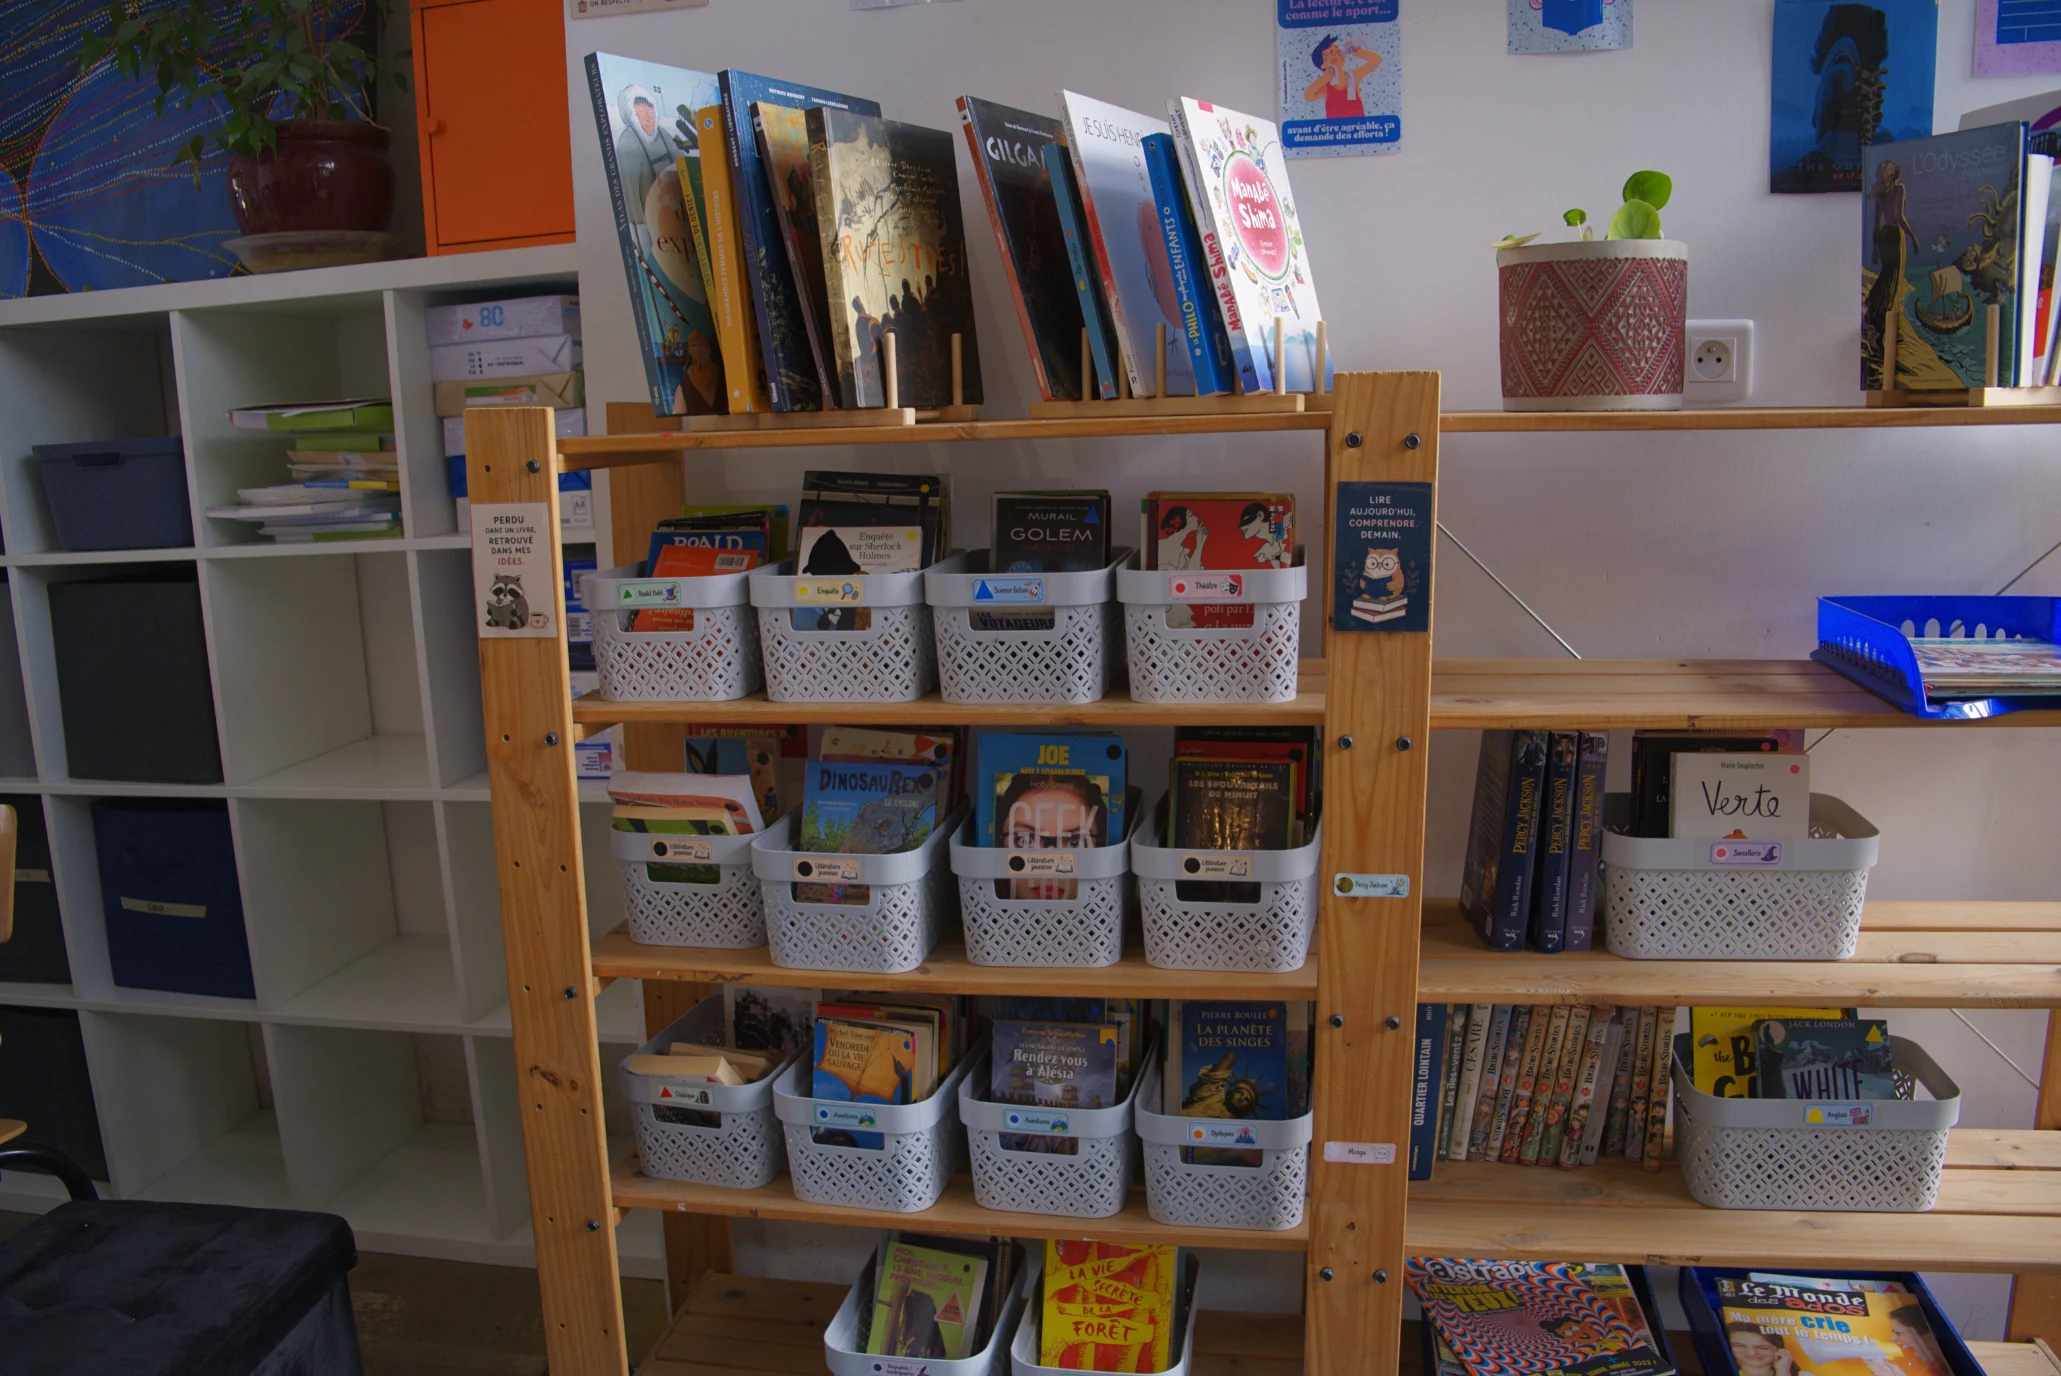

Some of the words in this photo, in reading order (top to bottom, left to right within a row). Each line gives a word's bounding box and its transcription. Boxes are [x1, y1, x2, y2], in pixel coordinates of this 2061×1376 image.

[1285, 9, 1330, 20] comme
[1332, 7, 1343, 17] le
[1287, 126, 1311, 134] avant
[1313, 124, 1340, 133] d'être
[1341, 121, 1382, 132] agréable,
[1294, 133, 1335, 142] demande
[1336, 131, 1351, 140] des
[1353, 129, 1383, 139] efforts
[1913, 142, 2005, 175] L'Odyssée
[1798, 162, 1827, 171] THE
[1238, 203, 1276, 230] Shima
[1165, 217, 1182, 269] ENFANTS
[717, 242, 727, 275] FEMMES
[1203, 232, 1227, 278] Shima
[720, 275, 732, 313] GRANDES
[1369, 495, 1392, 504] LIRE
[1027, 512, 1076, 521] MURAIL
[1349, 507, 1416, 517] AUJOURD'HUI,
[493, 516, 525, 525] PERDU
[488, 536, 534, 545] RETROUVÉ
[859, 532, 894, 542] Enquête
[1010, 528, 1093, 541] GOLEM
[1360, 530, 1402, 539] DEMAIN.
[491, 547, 513, 555] DANS
[864, 542, 902, 551] Sherlock
[498, 556, 526, 566] IDÉES.
[858, 551, 891, 560] Holmes
[817, 587, 840, 596] Enquête
[1195, 582, 1218, 590] Théâtre
[1226, 605, 1244, 615] par
[979, 617, 1055, 630] VOYAGEURS
[1037, 745, 1070, 765] JOE
[1518, 776, 1535, 821] JACKSON
[1552, 777, 1568, 821] JACKSON
[1581, 774, 1596, 818] JACKSON
[1701, 779, 1781, 818] Verte
[1513, 822, 1530, 855] PERCY
[1549, 821, 1565, 855] PERCY
[1577, 818, 1592, 852] PERCY
[1733, 849, 1762, 857] Sorcellerie
[1355, 880, 1369, 890] Percy
[1554, 875, 1565, 902] Riordan
[1511, 899, 1520, 918] Rick
[1551, 901, 1561, 918] Rick
[1578, 896, 1587, 914] Rick
[1201, 1010, 1231, 1020] PIERRE
[1234, 1011, 1268, 1020] BOULLE
[1197, 1023, 1213, 1035] LA
[1217, 1023, 1273, 1035] PLANÈTE
[1788, 1021, 1811, 1029] JACK
[1814, 1020, 1856, 1029] LONDON
[829, 1037, 869, 1053] VENDREDI
[1198, 1037, 1222, 1047] DES
[1225, 1037, 1271, 1047] SINGES
[1465, 1019, 1485, 1073] CESARE
[828, 1048, 839, 1057] OU
[841, 1051, 851, 1060] LA
[853, 1053, 865, 1062] VIE
[1420, 1037, 1432, 1081] LOINTAIN
[1713, 1050, 1734, 1063] the
[827, 1058, 863, 1072] SAUVAGE
[1025, 1062, 1033, 1076] à
[1036, 1064, 1074, 1080] Alésia
[1444, 1090, 1455, 1107] Les
[1451, 1041, 1461, 1066] vent
[1414, 1081, 1429, 1126] QUARTIER
[1827, 1111, 1848, 1121] Anglais
[1348, 1148, 1366, 1158] Manga
[1069, 1270, 1087, 1281] LA
[1091, 1260, 1117, 1276] VIE
[1091, 1279, 1145, 1307] SECRÈTE
[1423, 1283, 1492, 1294] ATTENTION
[1738, 1282, 1767, 1297] Le
[1768, 1284, 1865, 1306] Monde
[1082, 1305, 1096, 1315] DE
[1099, 1305, 1113, 1314] LA
[1747, 1296, 1779, 1305] des
[1784, 1297, 1865, 1317] ados
[1729, 1311, 1752, 1323] Ma
[1756, 1314, 1797, 1326] mère
[1799, 1315, 1851, 1334] crie
[1072, 1319, 1139, 1342] FORÊT
[1759, 1325, 1791, 1336] tout
[1795, 1327, 1809, 1339] le
[1814, 1329, 1861, 1345] temps
